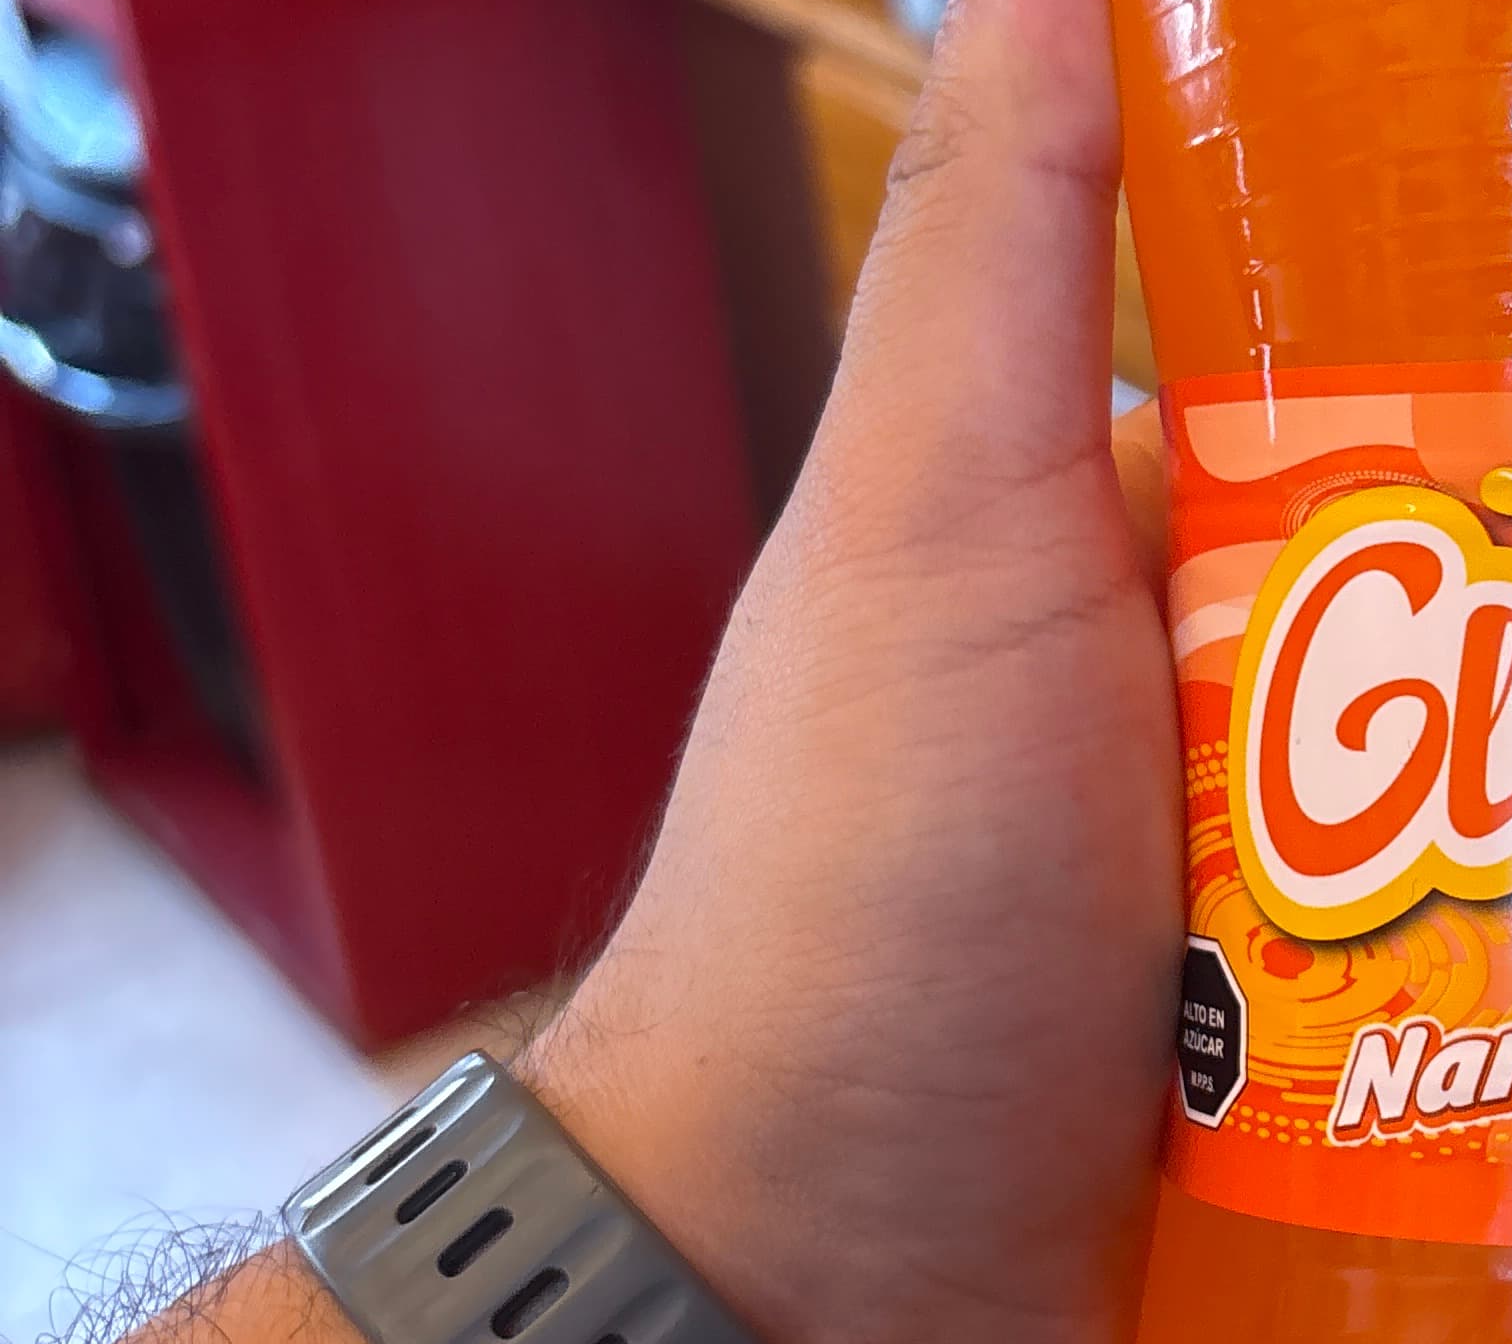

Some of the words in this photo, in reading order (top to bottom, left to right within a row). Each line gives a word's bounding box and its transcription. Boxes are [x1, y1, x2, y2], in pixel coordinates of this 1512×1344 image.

[1183, 999, 1207, 1024] ALTO
[1209, 1006, 1225, 1030] EN
[1184, 1027, 1225, 1059] AZÚCAR
